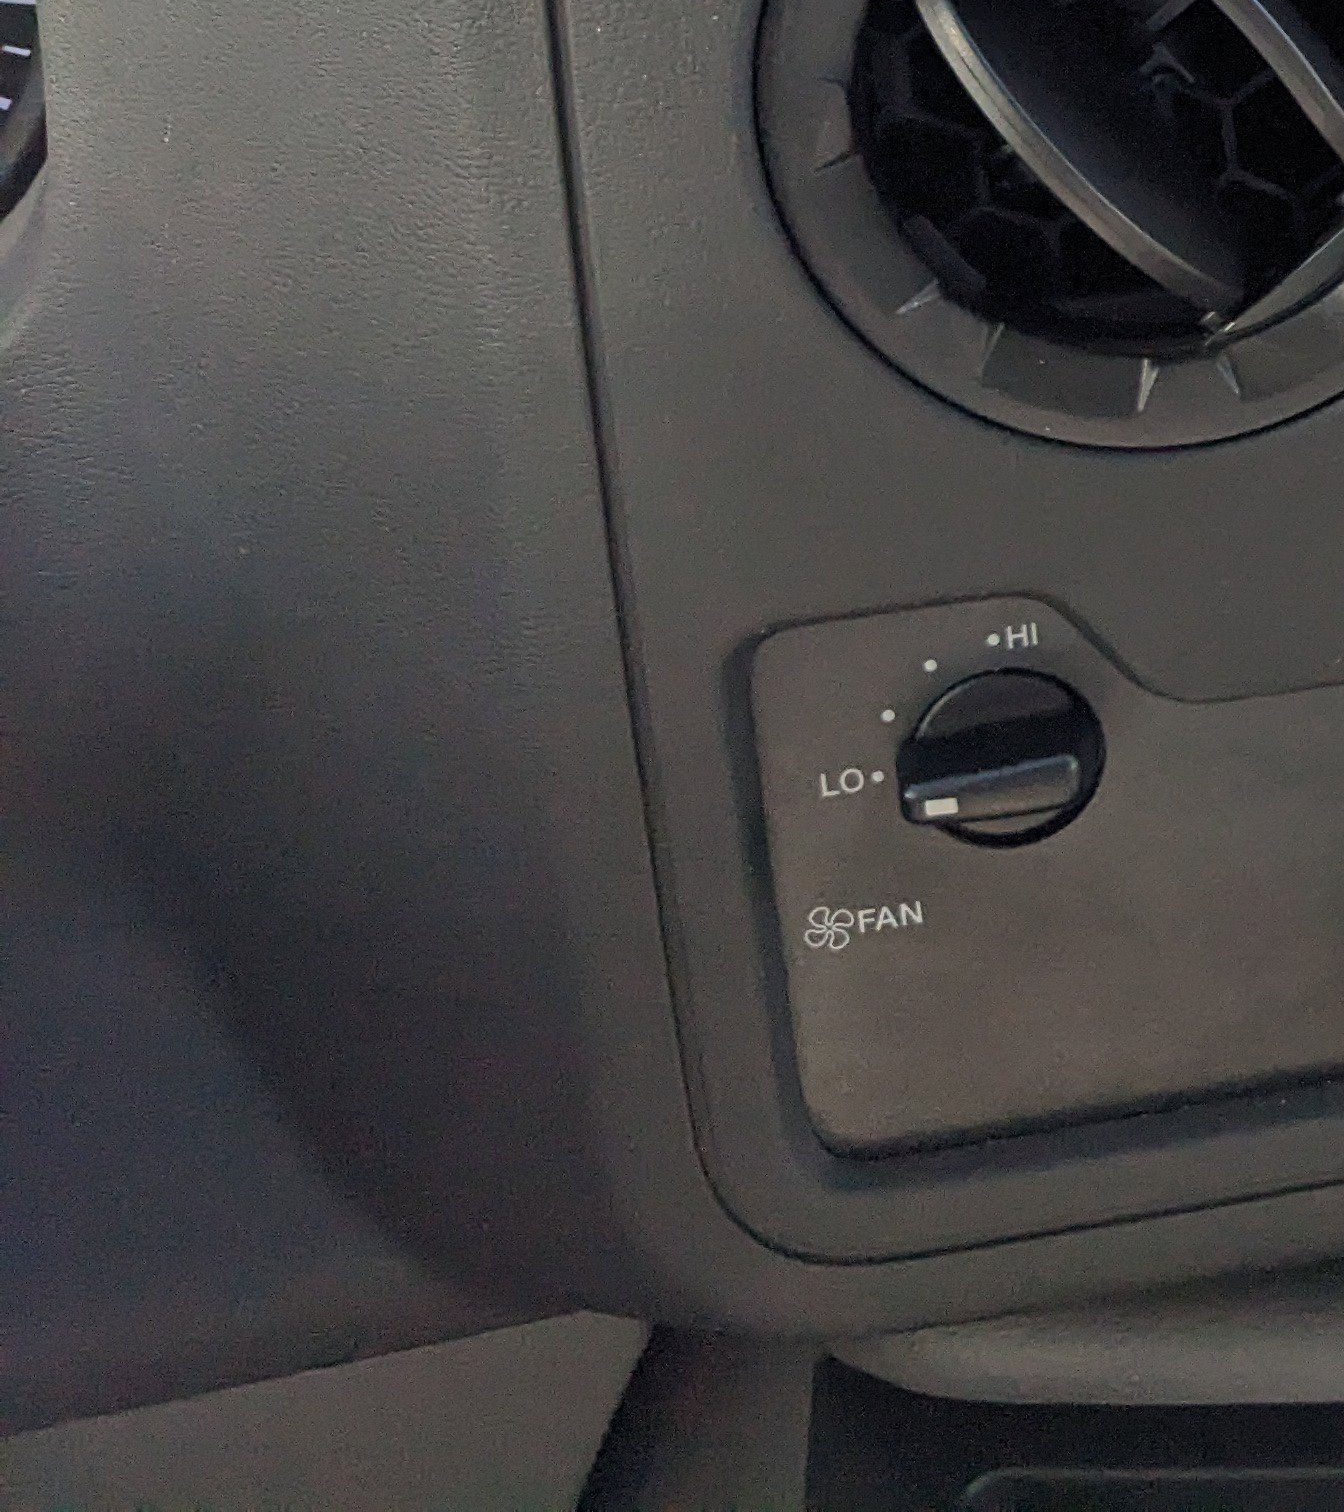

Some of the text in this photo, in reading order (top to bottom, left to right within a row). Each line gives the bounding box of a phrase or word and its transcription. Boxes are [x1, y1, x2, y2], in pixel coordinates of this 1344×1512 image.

[1005, 622, 1039, 650] HI
[819, 768, 865, 798] LO
[857, 900, 925, 934] FAN
